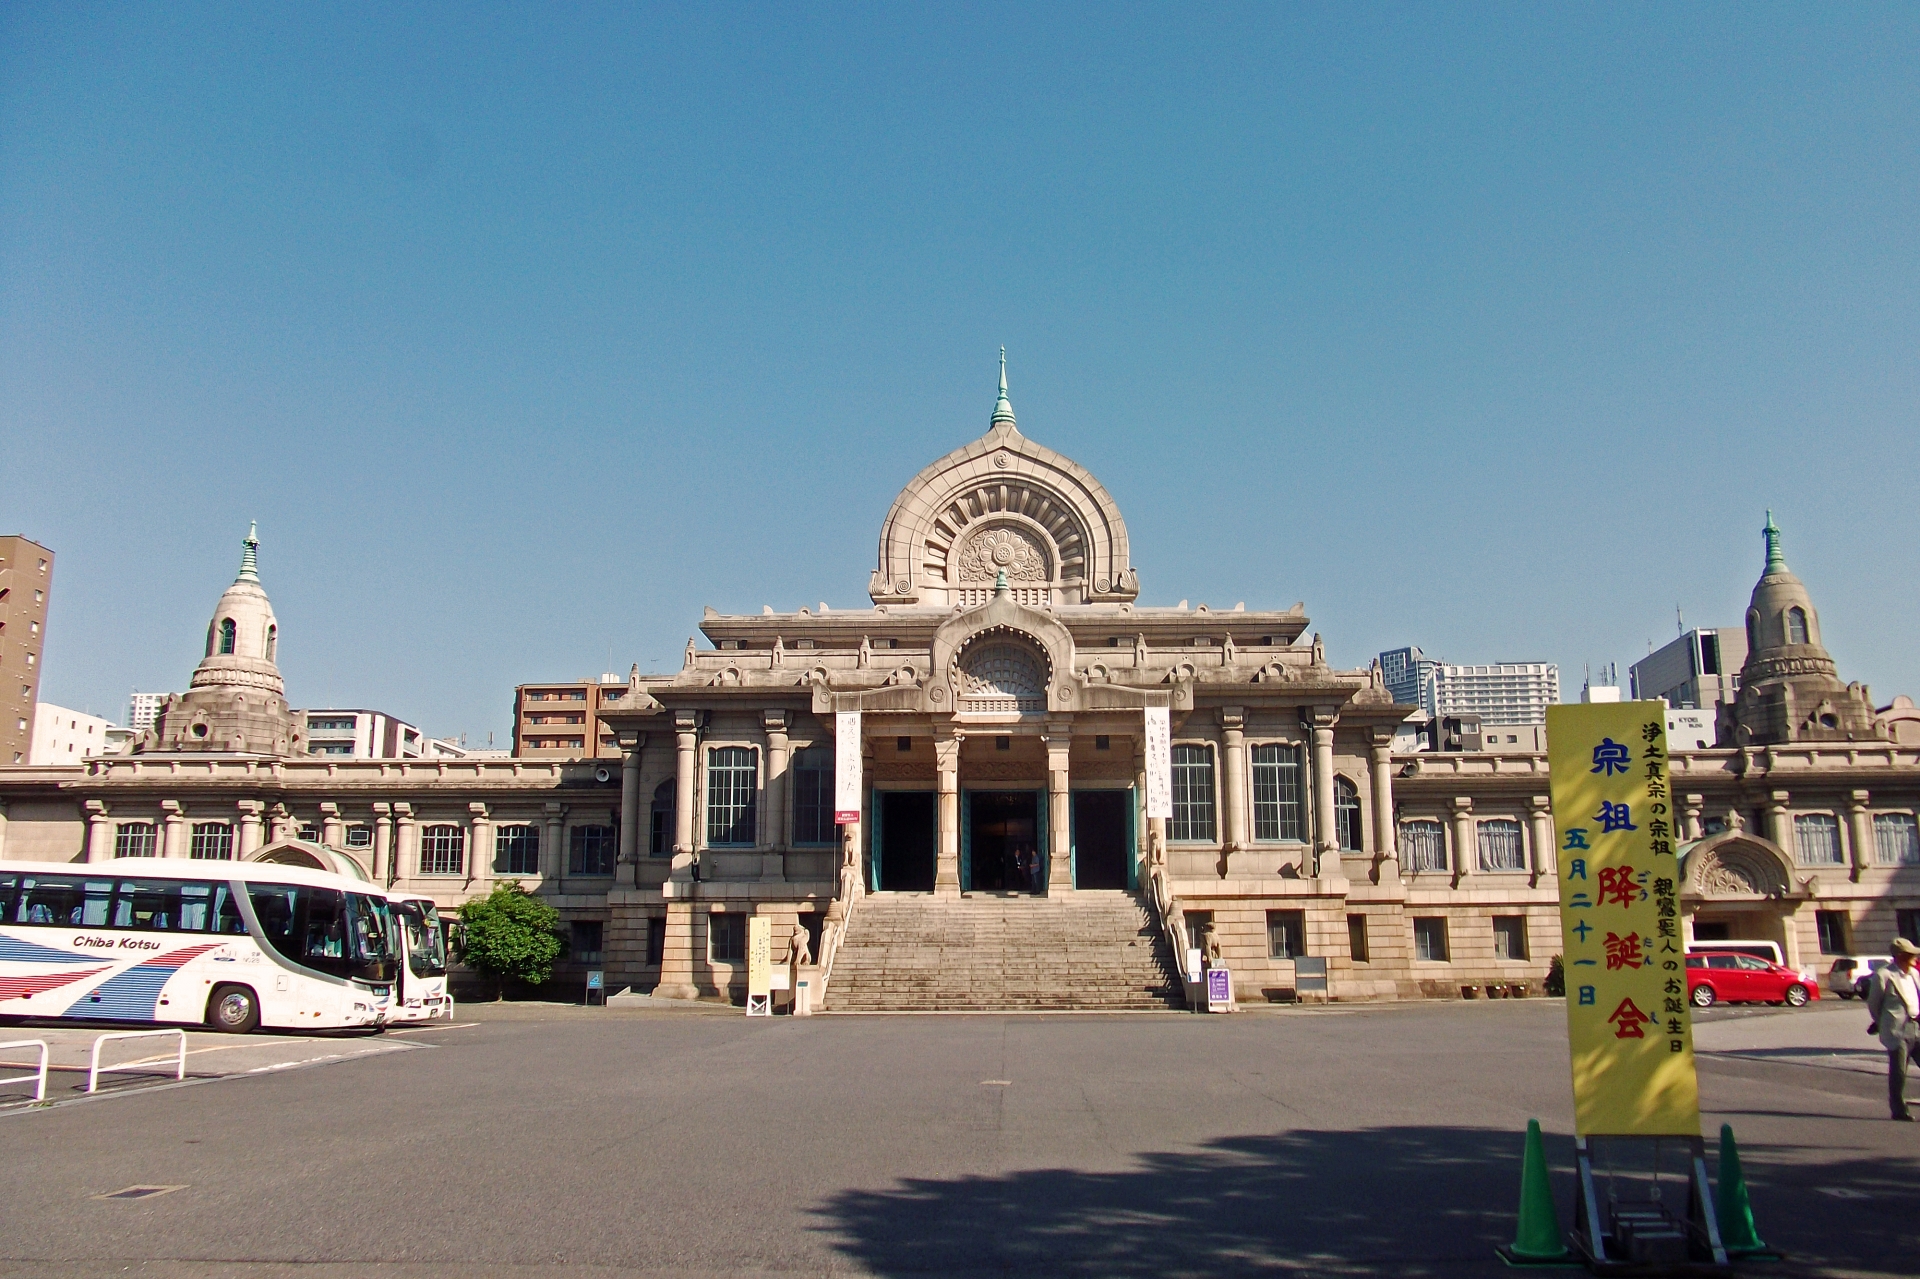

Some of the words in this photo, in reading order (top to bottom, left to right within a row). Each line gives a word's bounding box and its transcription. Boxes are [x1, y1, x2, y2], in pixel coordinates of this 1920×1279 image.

[1642, 722, 1673, 856] 浄土真宗の宗祖
[73, 936, 115, 948] Chiba
[118, 938, 161, 950] Kotsu
[1562, 828, 1597, 1006] 五月二十一日
[1590, 737, 1649, 1039] 宗祖降誕会
[1653, 877, 1684, 1053] 親鸞聖人のお誕生日
